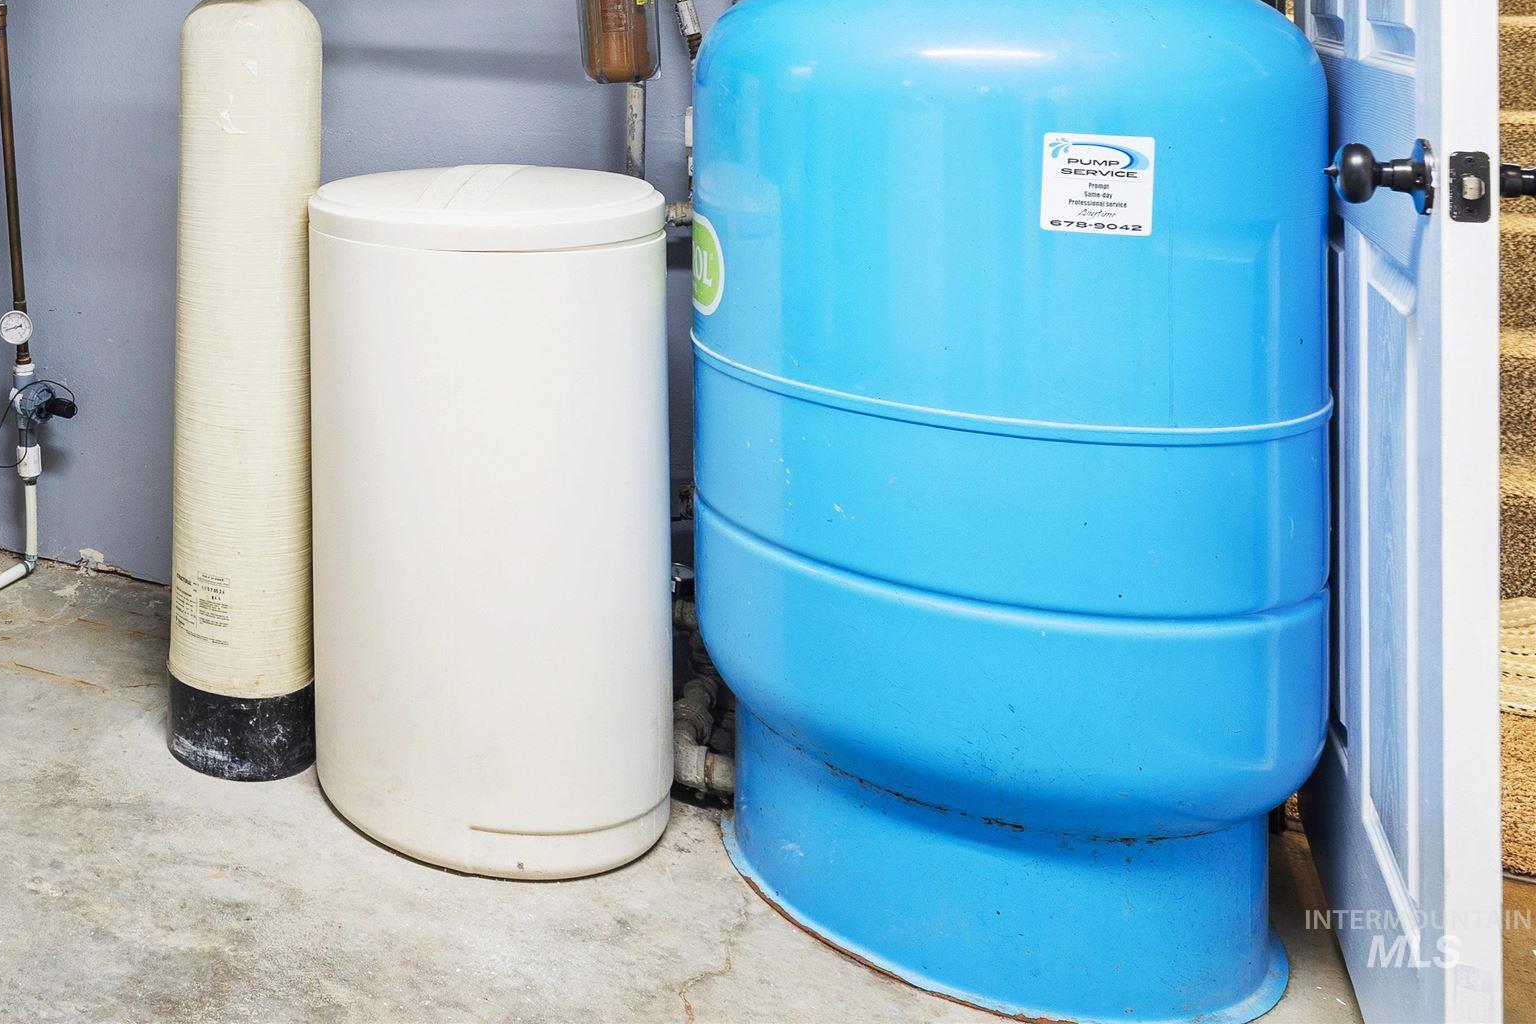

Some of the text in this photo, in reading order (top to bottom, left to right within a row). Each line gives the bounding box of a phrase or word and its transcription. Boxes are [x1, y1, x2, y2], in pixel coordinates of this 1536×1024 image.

[1067, 158, 1120, 167] PUMP
[1060, 168, 1138, 179] SERVICE
[1088, 182, 1110, 190] Prompt
[1084, 191, 1113, 199] Same-day
[1068, 199, 1128, 209] Professional service
[1077, 208, 1117, 220] Anytime
[1050, 220, 1142, 232] 678-9042
